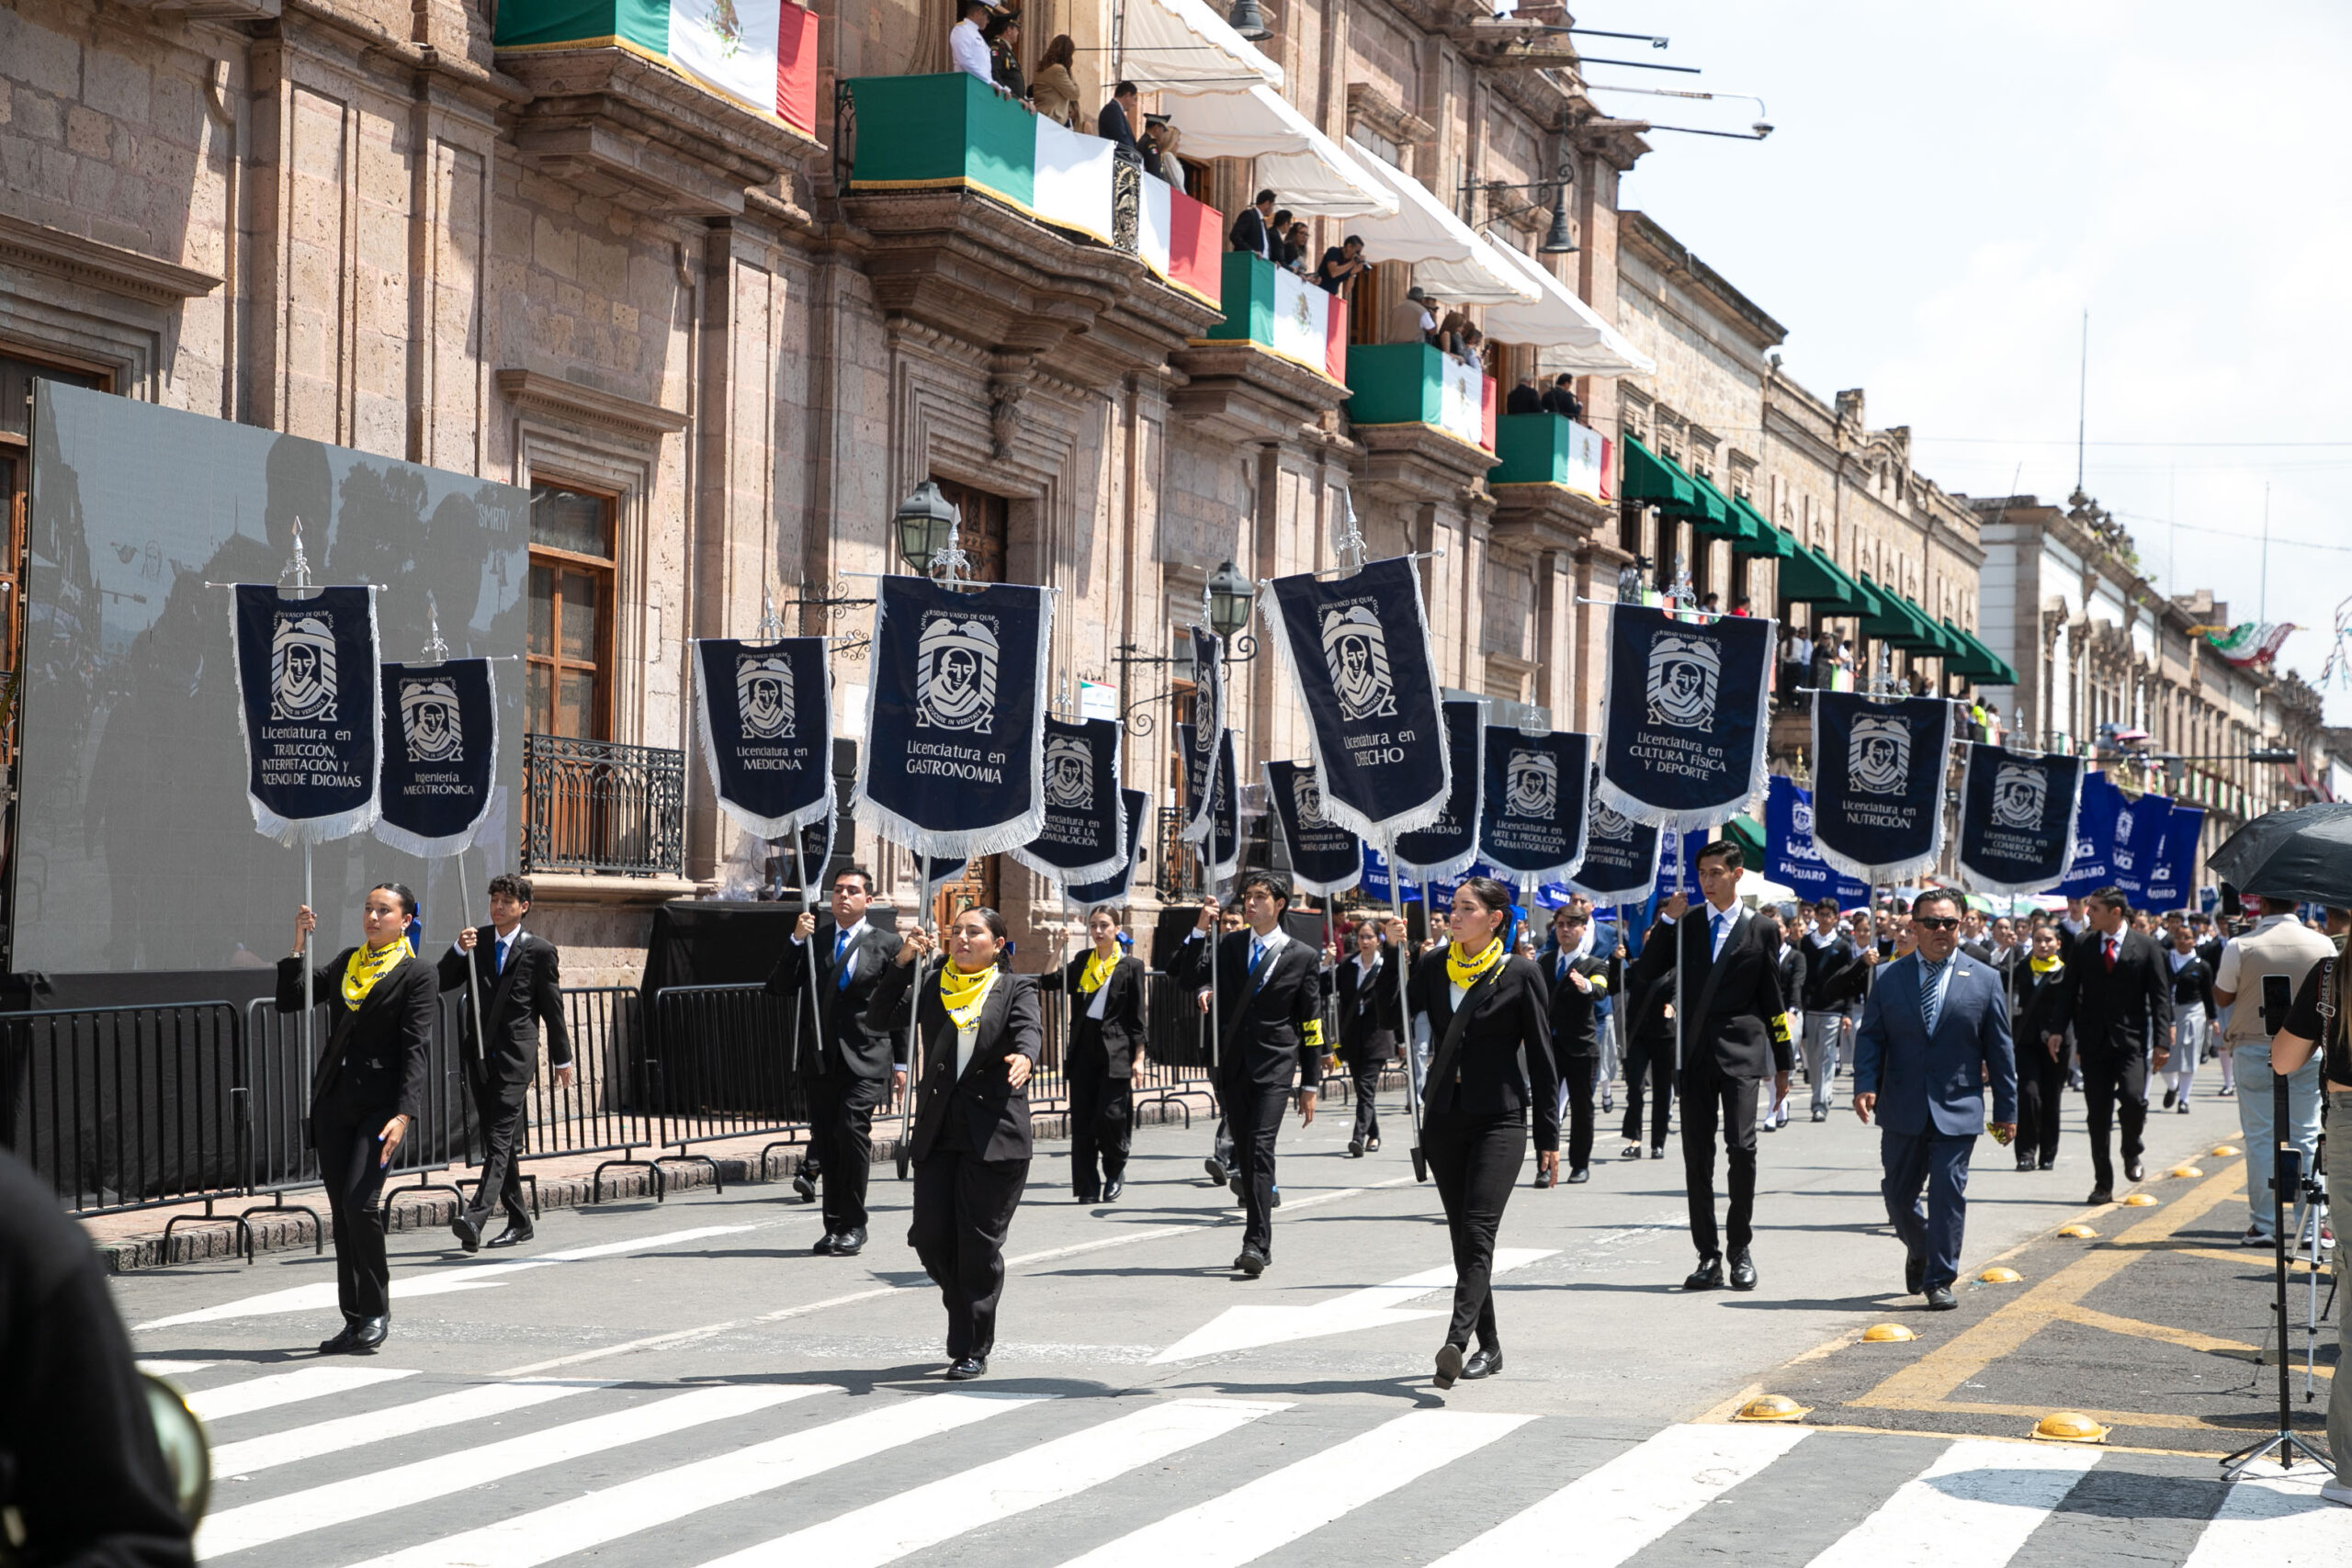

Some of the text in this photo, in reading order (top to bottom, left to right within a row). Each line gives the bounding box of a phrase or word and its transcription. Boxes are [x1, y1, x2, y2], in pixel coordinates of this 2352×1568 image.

[979, 615, 1000, 636] QUIROGA
[956, 708, 983, 725] VERITATE
[262, 726, 351, 740] Licenciatura en
[1397, 729, 1416, 742] en
[737, 746, 808, 757] Licenciatura en
[907, 739, 1006, 764] Licenciatura en
[1637, 732, 1723, 758] Licenciatura en
[343, 761, 349, 773] Y
[743, 759, 802, 771] MEDICINA
[1629, 746, 1726, 773] CULTURA FÍSICA
[414, 772, 459, 784] Ingeniería
[906, 759, 1002, 784] GASTRONOMIA
[1645, 760, 1710, 781] Y DEPORTE
[294, 773, 307, 784] DE
[311, 773, 362, 787] IDIOMAS
[1842, 799, 1917, 817] Licenciatura en
[1088, 819, 1100, 829] en
[1497, 819, 1562, 836] Licenciatura en
[1847, 811, 1911, 829] NUTRICIÓN
[1069, 825, 1081, 835] DE
[1084, 826, 1095, 837] LA
[1490, 829, 1510, 840] ARTE
[1520, 833, 1566, 846] PRODUCCIÓN
[2036, 839, 2048, 847] en
[1587, 844, 1640, 859] icenciatura en
[1368, 874, 1389, 886] TRES
